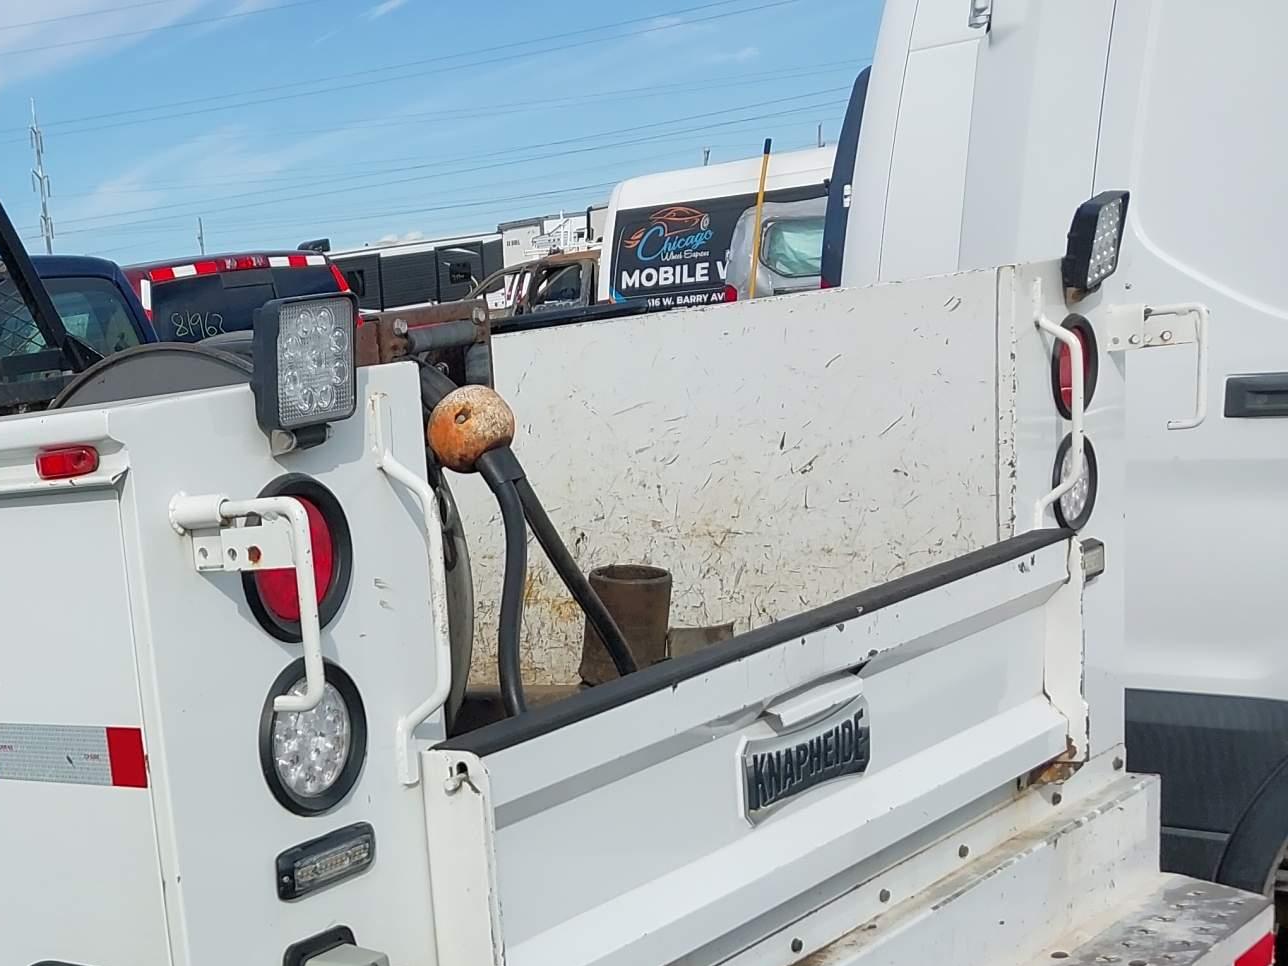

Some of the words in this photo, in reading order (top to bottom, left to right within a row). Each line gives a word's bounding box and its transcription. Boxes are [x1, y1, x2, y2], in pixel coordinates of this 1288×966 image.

[637, 225, 713, 261] Chicago
[621, 262, 710, 289] MOBILE
[662, 296, 674, 306] W.
[676, 294, 709, 305] BARRY
[749, 707, 865, 812] KNAPHEIDE
